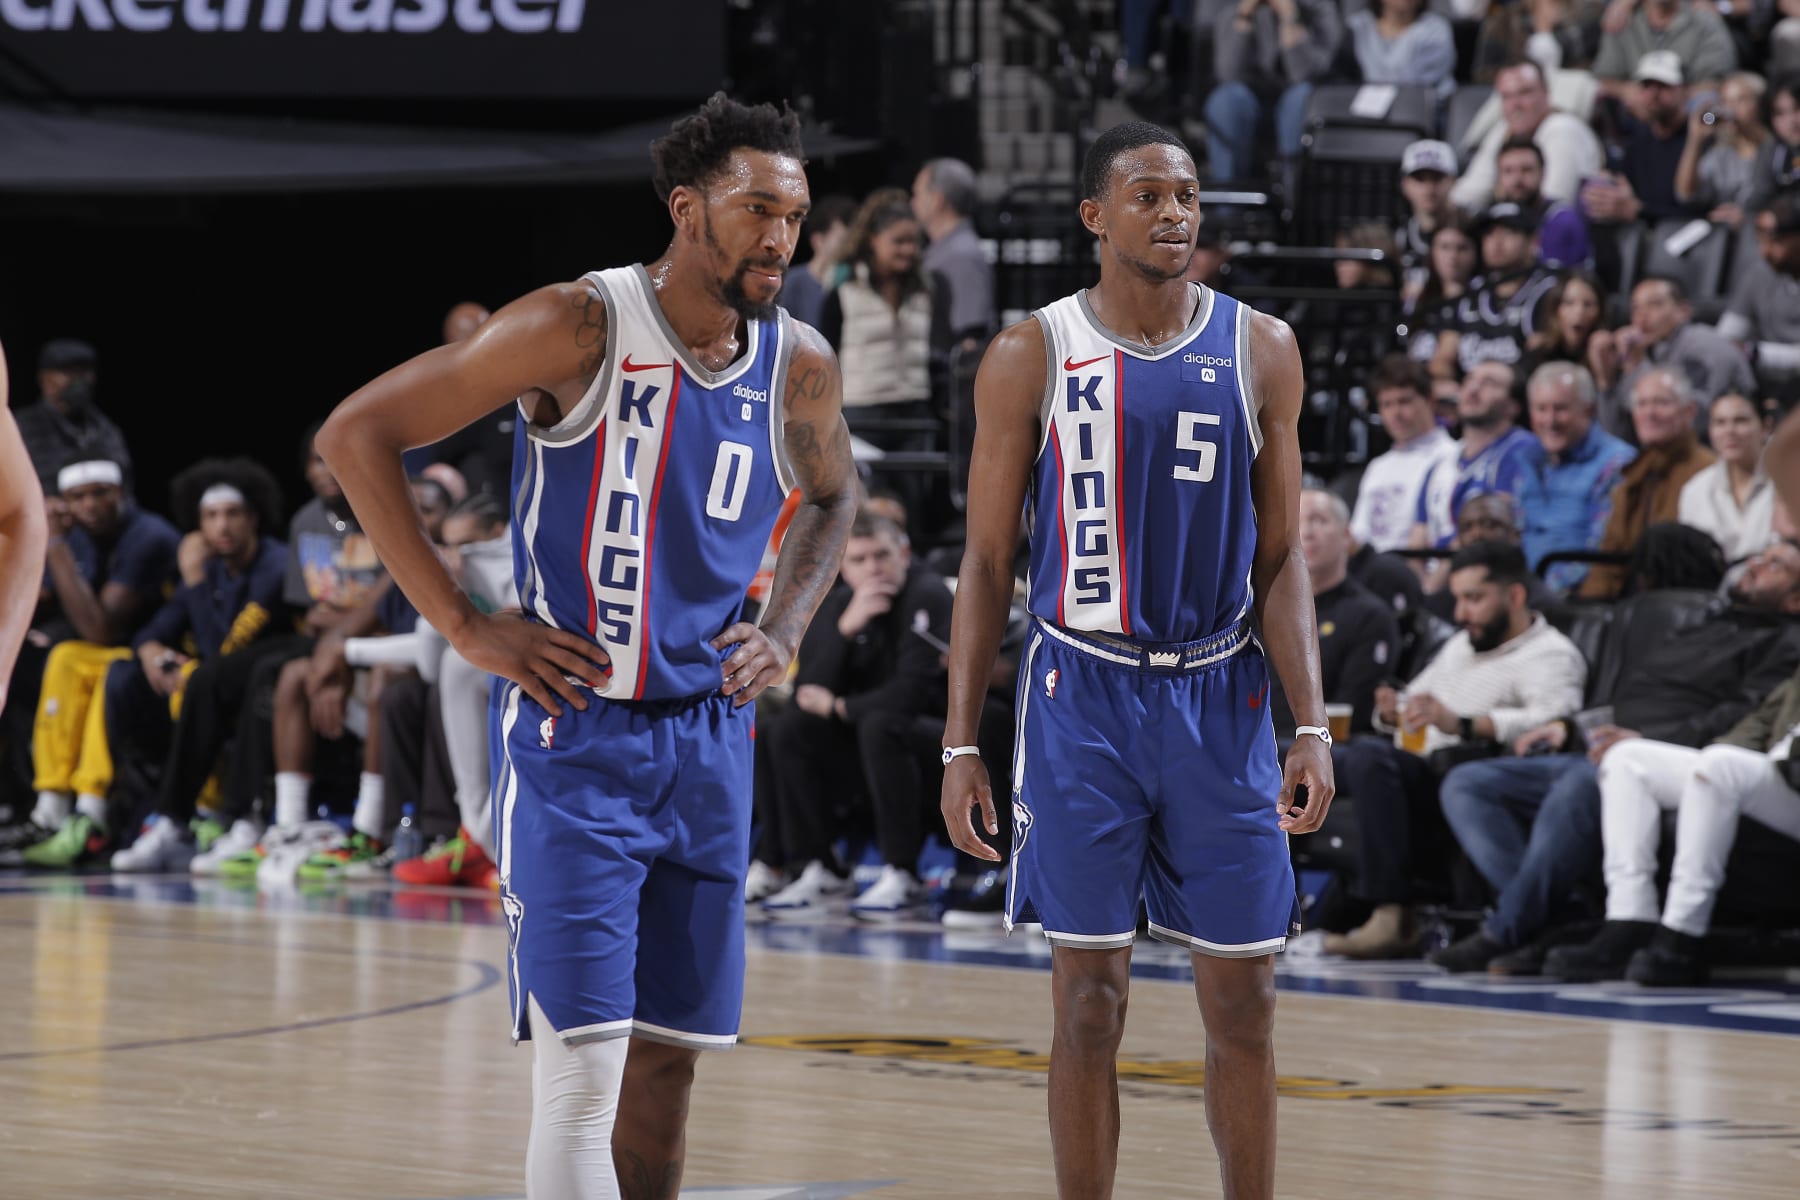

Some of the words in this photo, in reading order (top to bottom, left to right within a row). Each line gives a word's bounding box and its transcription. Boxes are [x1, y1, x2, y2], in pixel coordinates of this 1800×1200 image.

[1184, 352, 1232, 367] dialpad
[733, 384, 767, 402] dialpad
[1173, 411, 1220, 483] 5
[706, 440, 753, 521] 0
